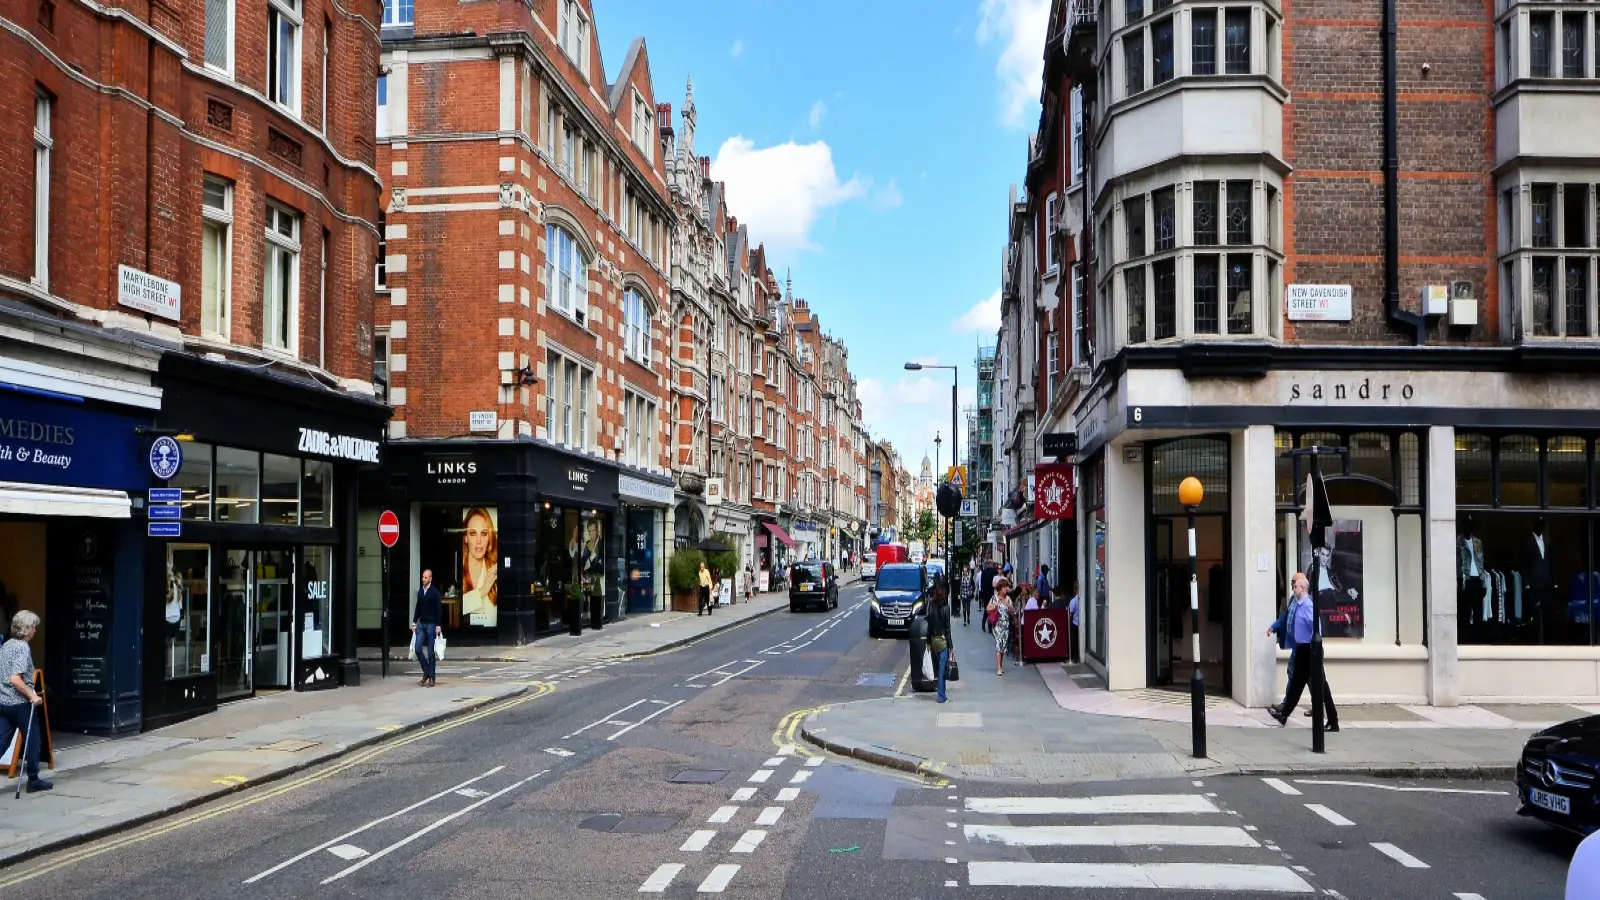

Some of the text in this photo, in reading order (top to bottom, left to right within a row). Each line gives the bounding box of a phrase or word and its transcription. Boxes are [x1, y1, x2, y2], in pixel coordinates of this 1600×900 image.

[123, 270, 169, 294] MARYLEBONE
[123, 282, 140, 296] HIGH
[142, 289, 166, 304] STREET
[168, 297, 177, 308] W1
[1292, 288, 1348, 298] NEW CAVENDISH
[1292, 299, 1328, 309] STREET W1
[1291, 378, 1414, 400] sandro
[1134, 407, 1142, 422] 6
[16, 446, 30, 462] &
[32, 448, 72, 469] Beauty
[427, 462, 477, 474] LINKS
[568, 470, 589, 484] LINKS
[307, 580, 327, 600] SALE
[1534, 791, 1567, 811] LR15 VHG
